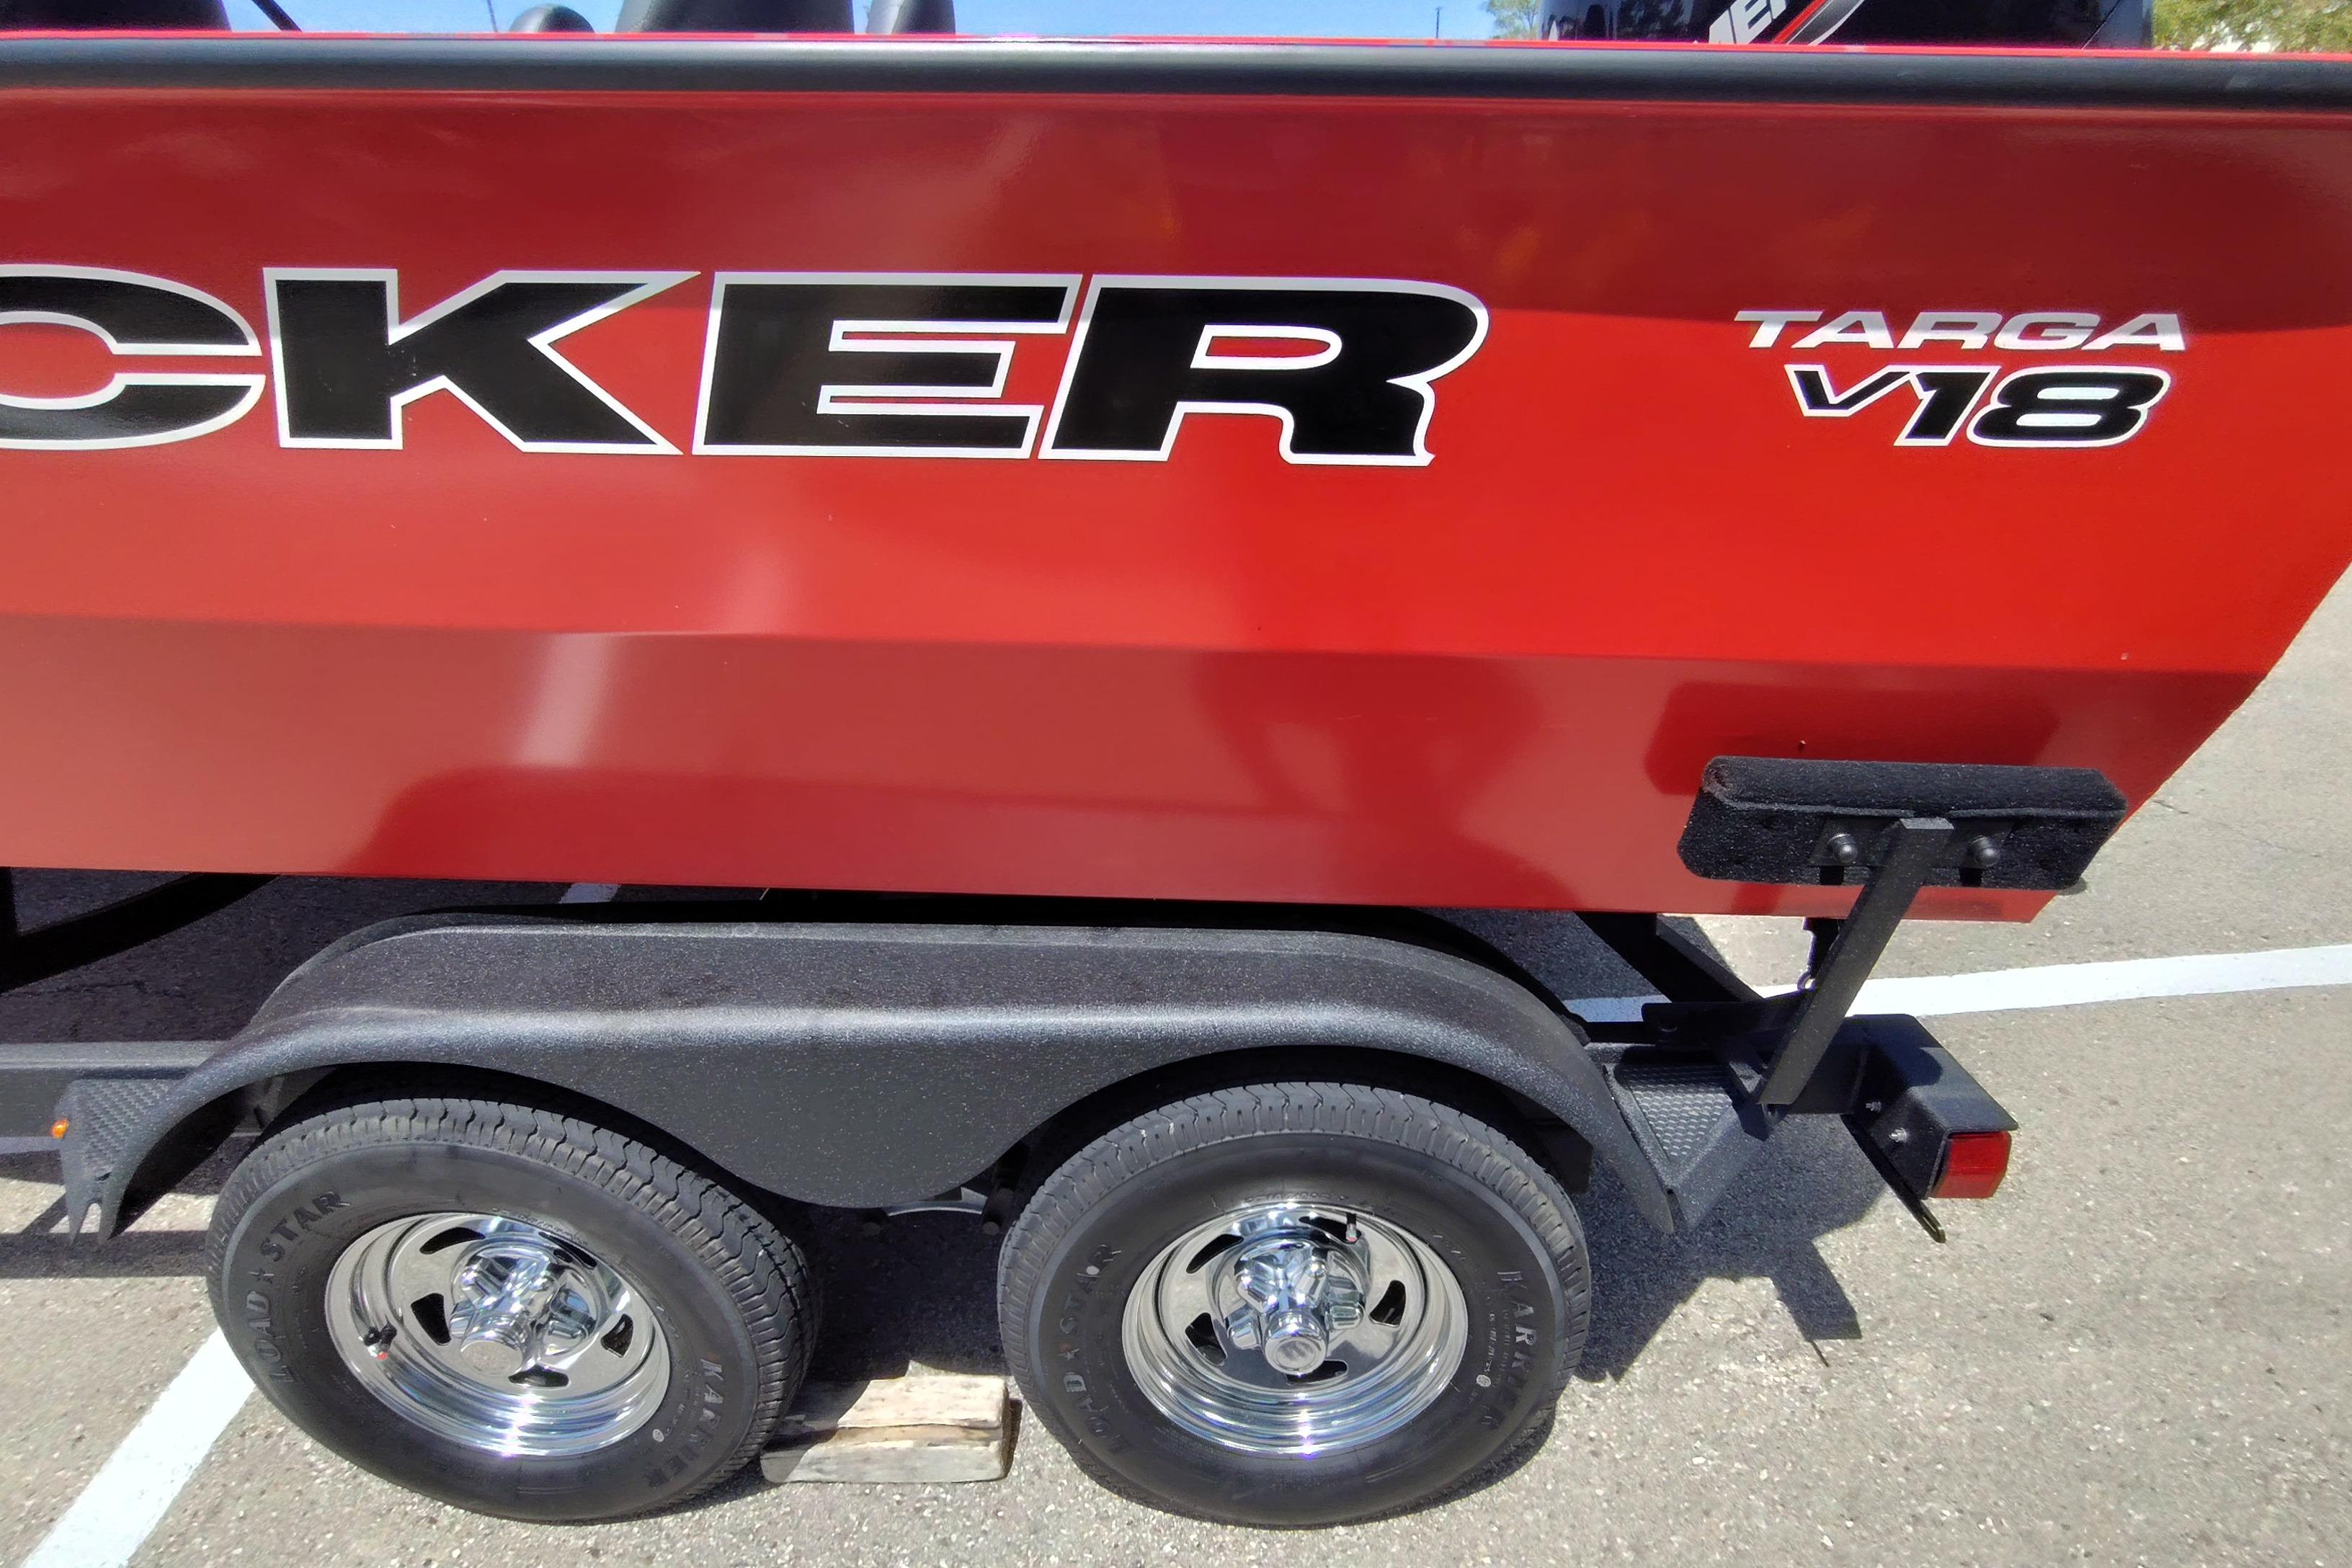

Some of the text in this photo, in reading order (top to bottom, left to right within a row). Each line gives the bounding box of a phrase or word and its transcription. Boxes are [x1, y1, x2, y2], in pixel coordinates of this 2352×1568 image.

[0, 264, 1489, 466] CKER
[1734, 310, 2186, 351] TARGA
[1784, 363, 2171, 447] V18
[246, 1190, 351, 1384] LOAD STAR
[1059, 1243, 1132, 1454] LOAD STAR
